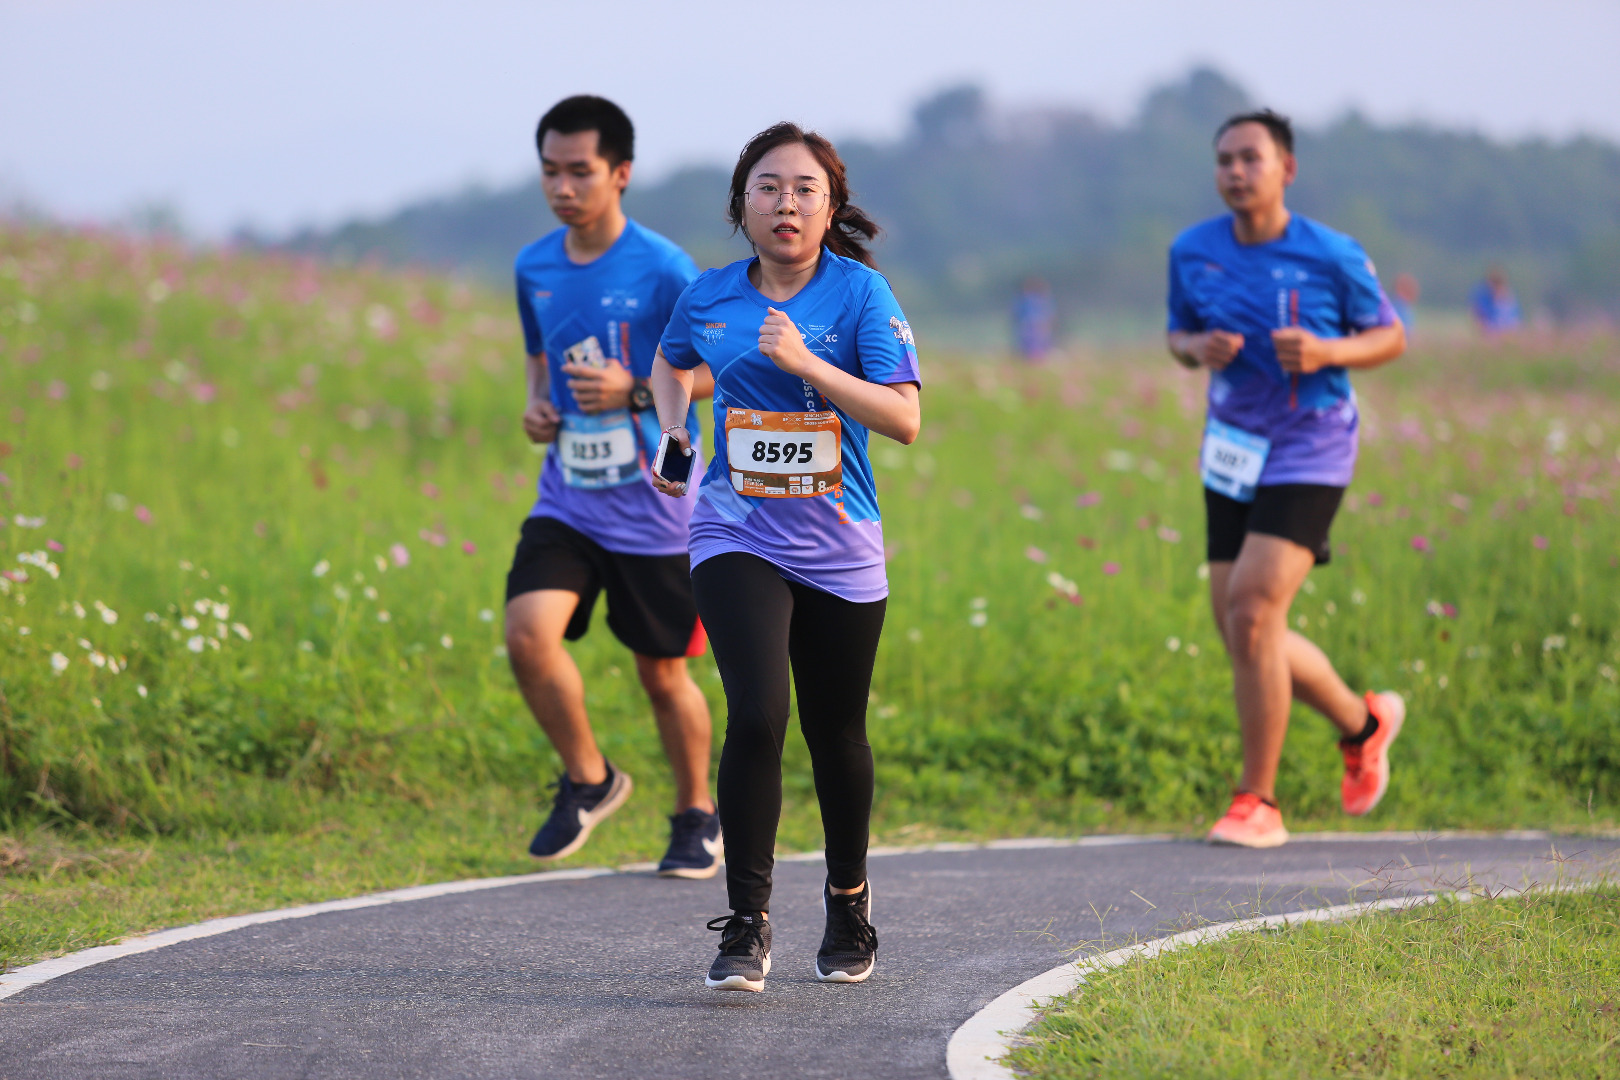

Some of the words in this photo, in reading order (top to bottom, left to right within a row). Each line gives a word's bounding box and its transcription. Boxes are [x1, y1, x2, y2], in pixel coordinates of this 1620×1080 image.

[825, 334, 838, 343] XC
[751, 440, 813, 464] 8595
[818, 480, 827, 493] 8
